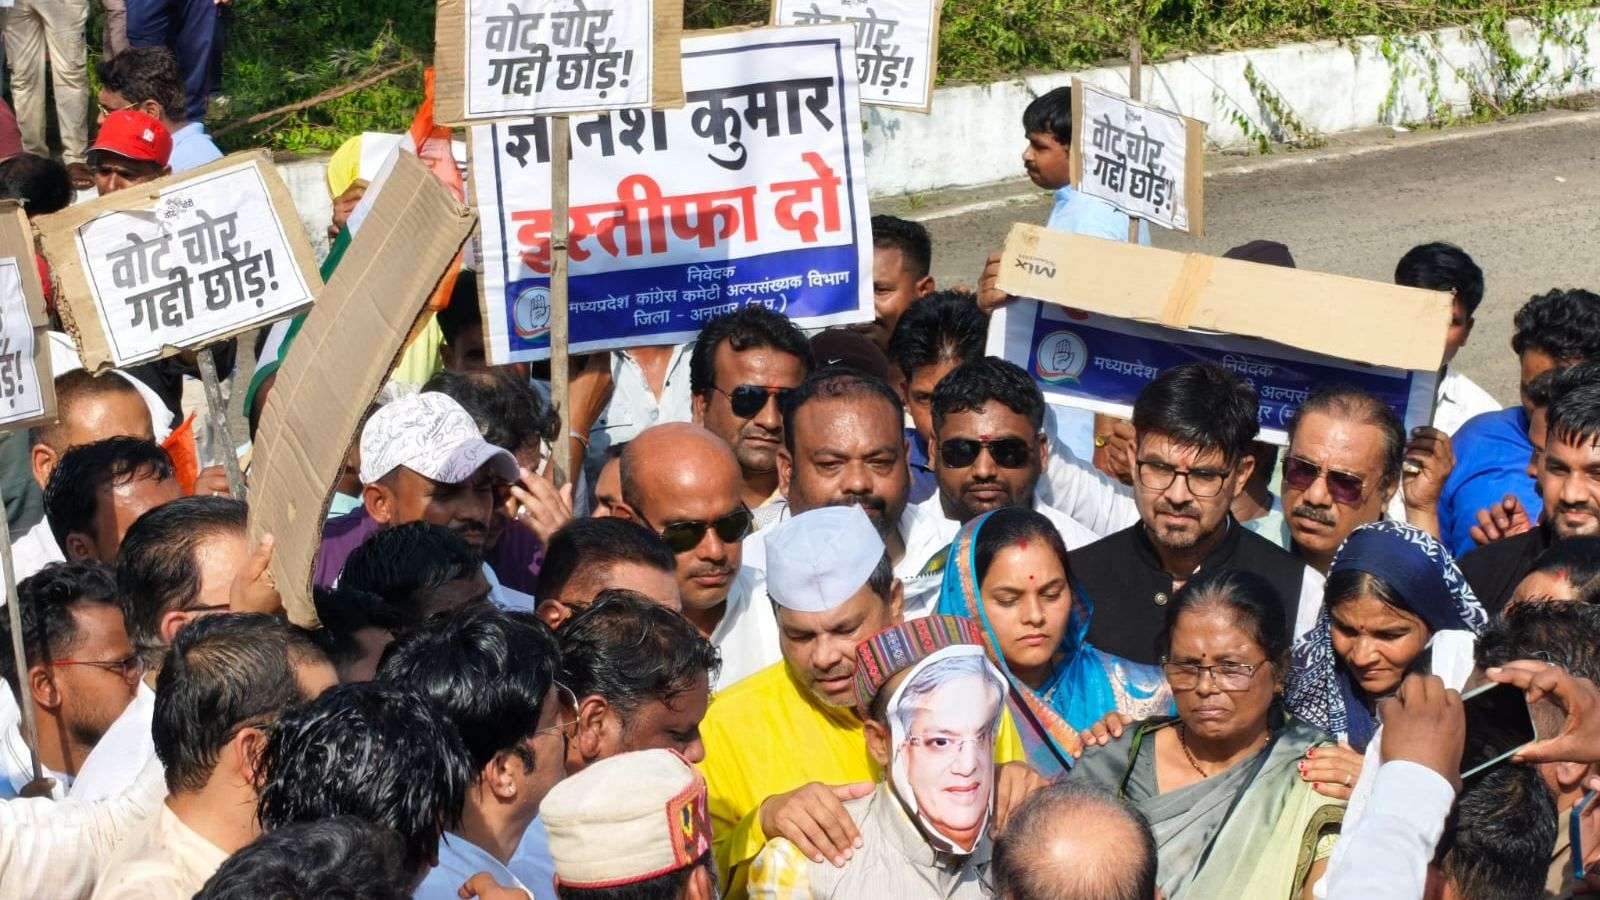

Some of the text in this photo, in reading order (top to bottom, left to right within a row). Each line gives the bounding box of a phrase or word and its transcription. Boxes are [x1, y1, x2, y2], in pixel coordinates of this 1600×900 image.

[485, 0, 616, 52] वोट चोर,
[488, 41, 634, 99] गद्दी छोड़!
[686, 76, 835, 171] कुमार
[1093, 113, 1166, 176] वोट चोर,
[511, 151, 842, 275] इस्तीफा दो
[1093, 154, 1174, 214] गद्दी छोड़!
[106, 209, 252, 289] वोट चोर,
[687, 264, 736, 283] निवेदक
[125, 249, 279, 331] गद्दी छोड़!
[568, 269, 850, 314] मध्यप्रदेश कांग्रेस कमेटी अल्पसंख्यक विभाग
[633, 310, 671, 327] जिला
[1094, 356, 1160, 380] मध्यप्रदेश
[1222, 354, 1273, 378] निवेदक
